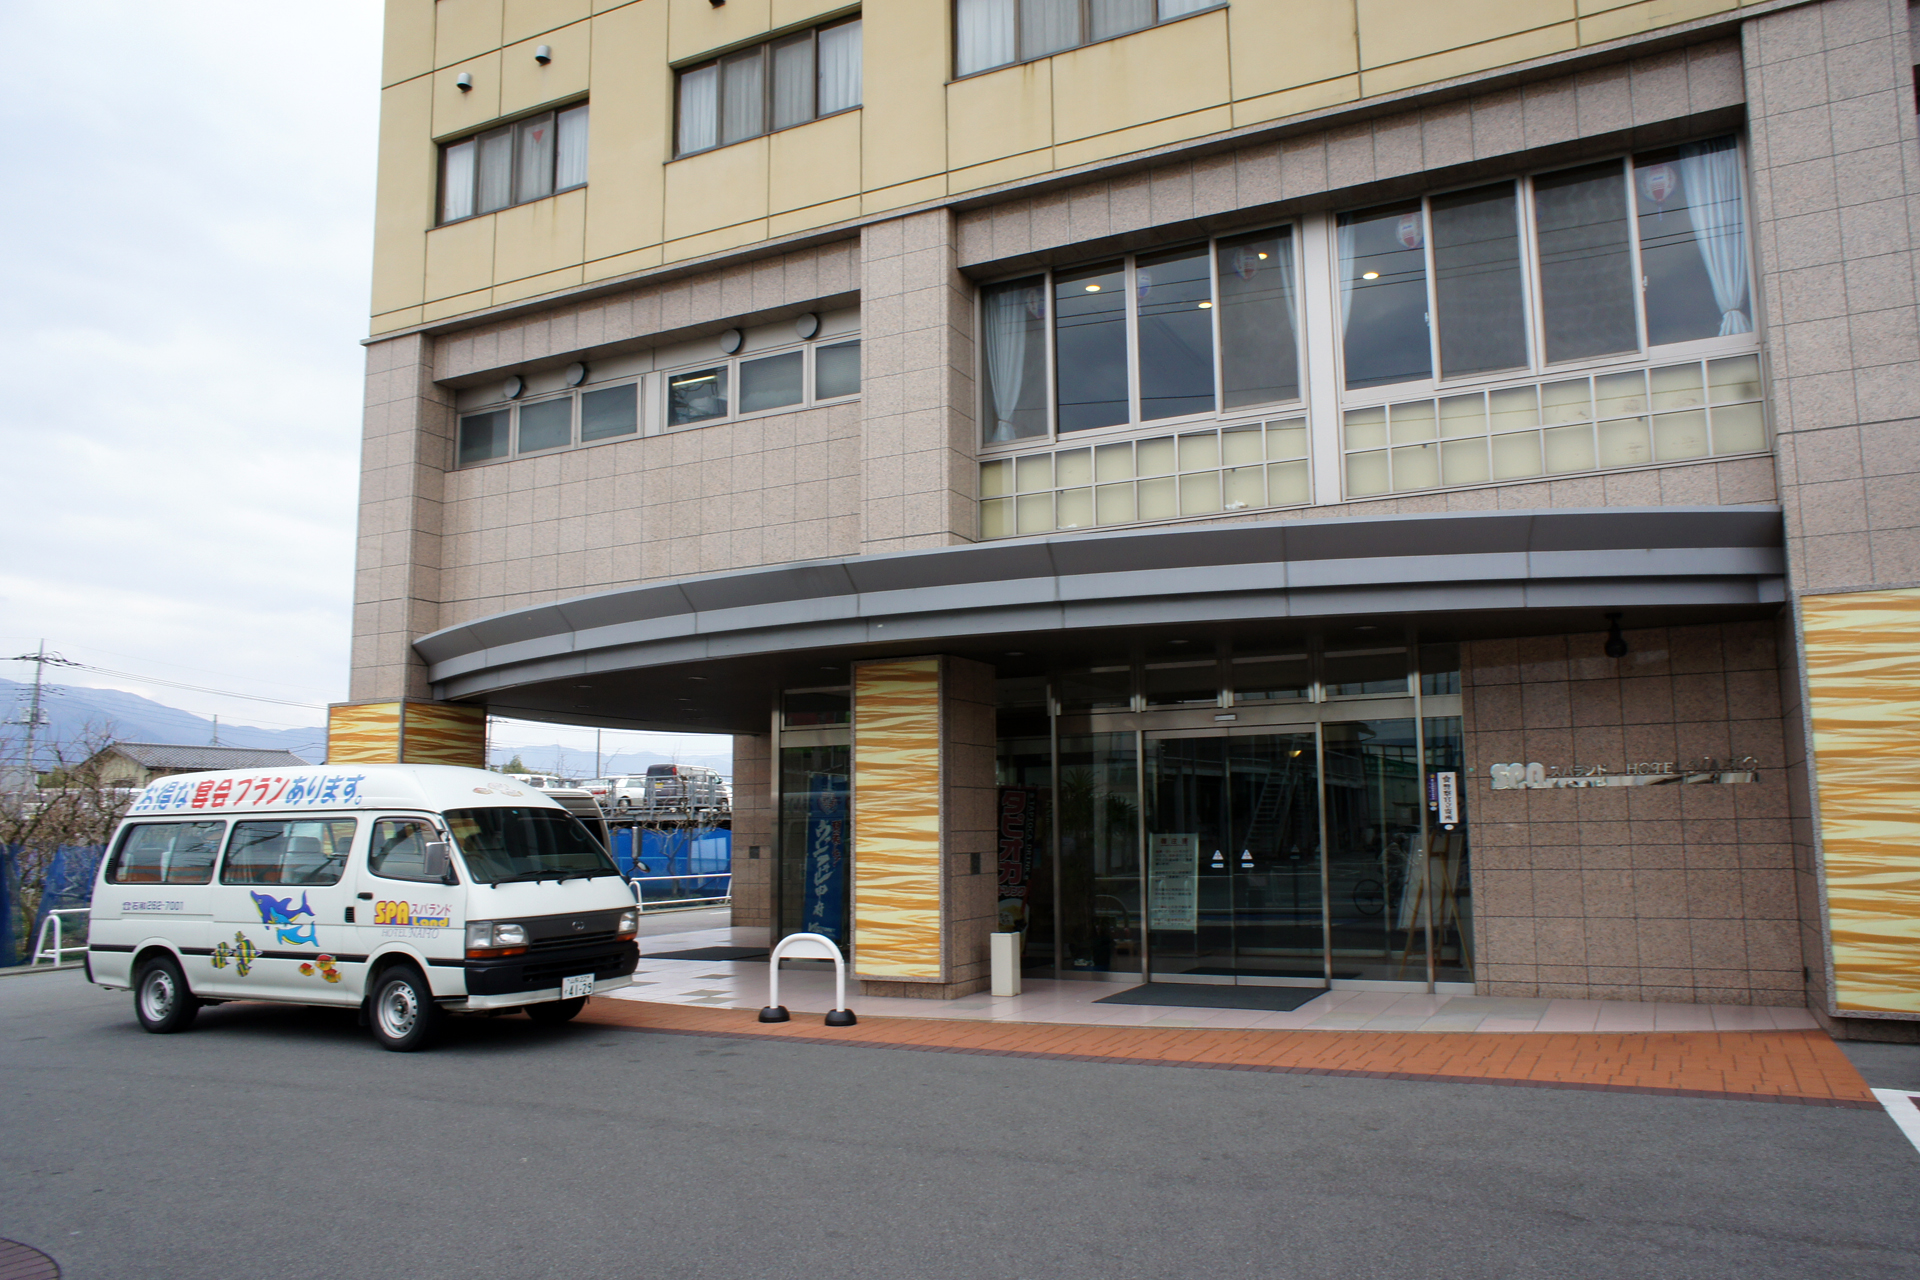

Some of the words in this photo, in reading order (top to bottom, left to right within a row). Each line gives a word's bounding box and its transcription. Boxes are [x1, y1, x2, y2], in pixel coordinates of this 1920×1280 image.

[1490, 762, 1545, 790] SPA
[998, 790, 1027, 885] タピオカ
[374, 900, 410, 925] SPA
[412, 916, 449, 928] Land
